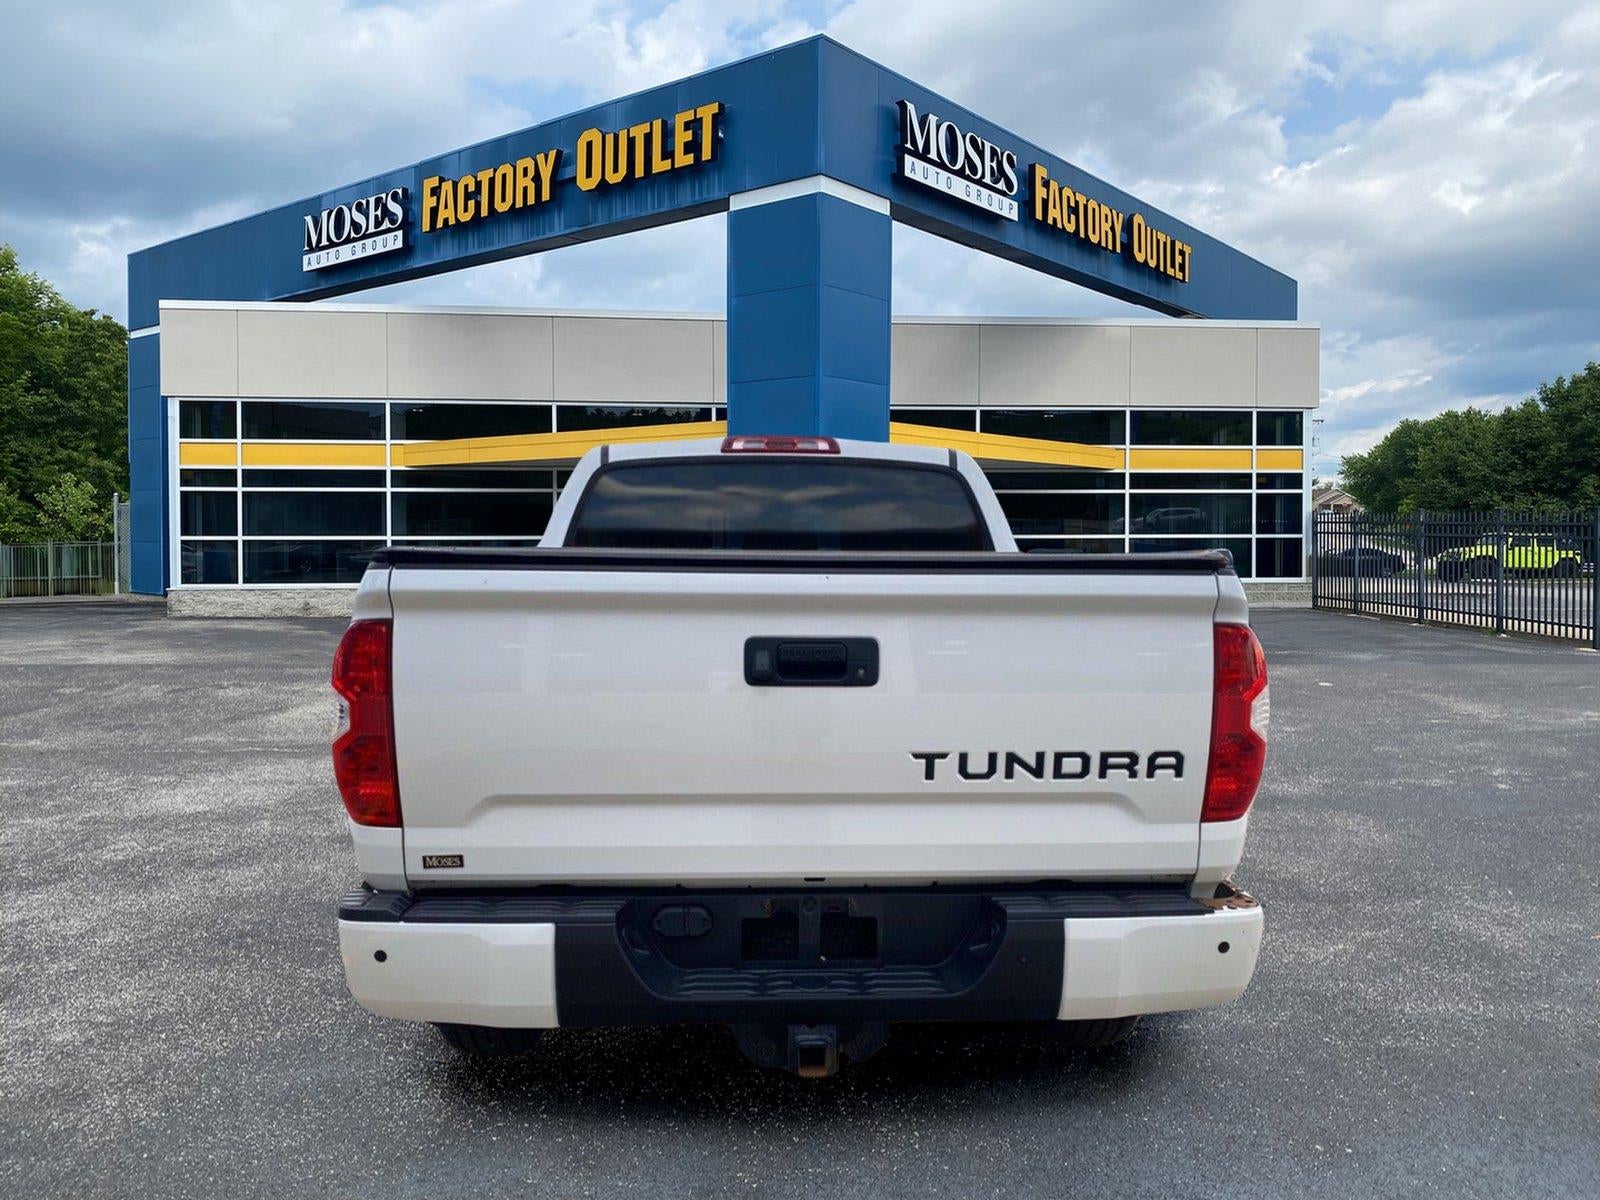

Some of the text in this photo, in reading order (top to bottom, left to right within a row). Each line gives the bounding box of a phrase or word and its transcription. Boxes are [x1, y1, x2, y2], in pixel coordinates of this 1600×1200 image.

[422, 102, 719, 232] FACTORY OUTLET
[903, 100, 1018, 195] MOSES
[909, 161, 1015, 214] AUTO GROUP
[303, 188, 404, 251] MOSES
[1034, 164, 1192, 283] FACTORY OUTLET
[306, 234, 400, 268] AUTO GROUP
[909, 751, 1184, 781] TUNDRA
[425, 857, 461, 867] MOSES
